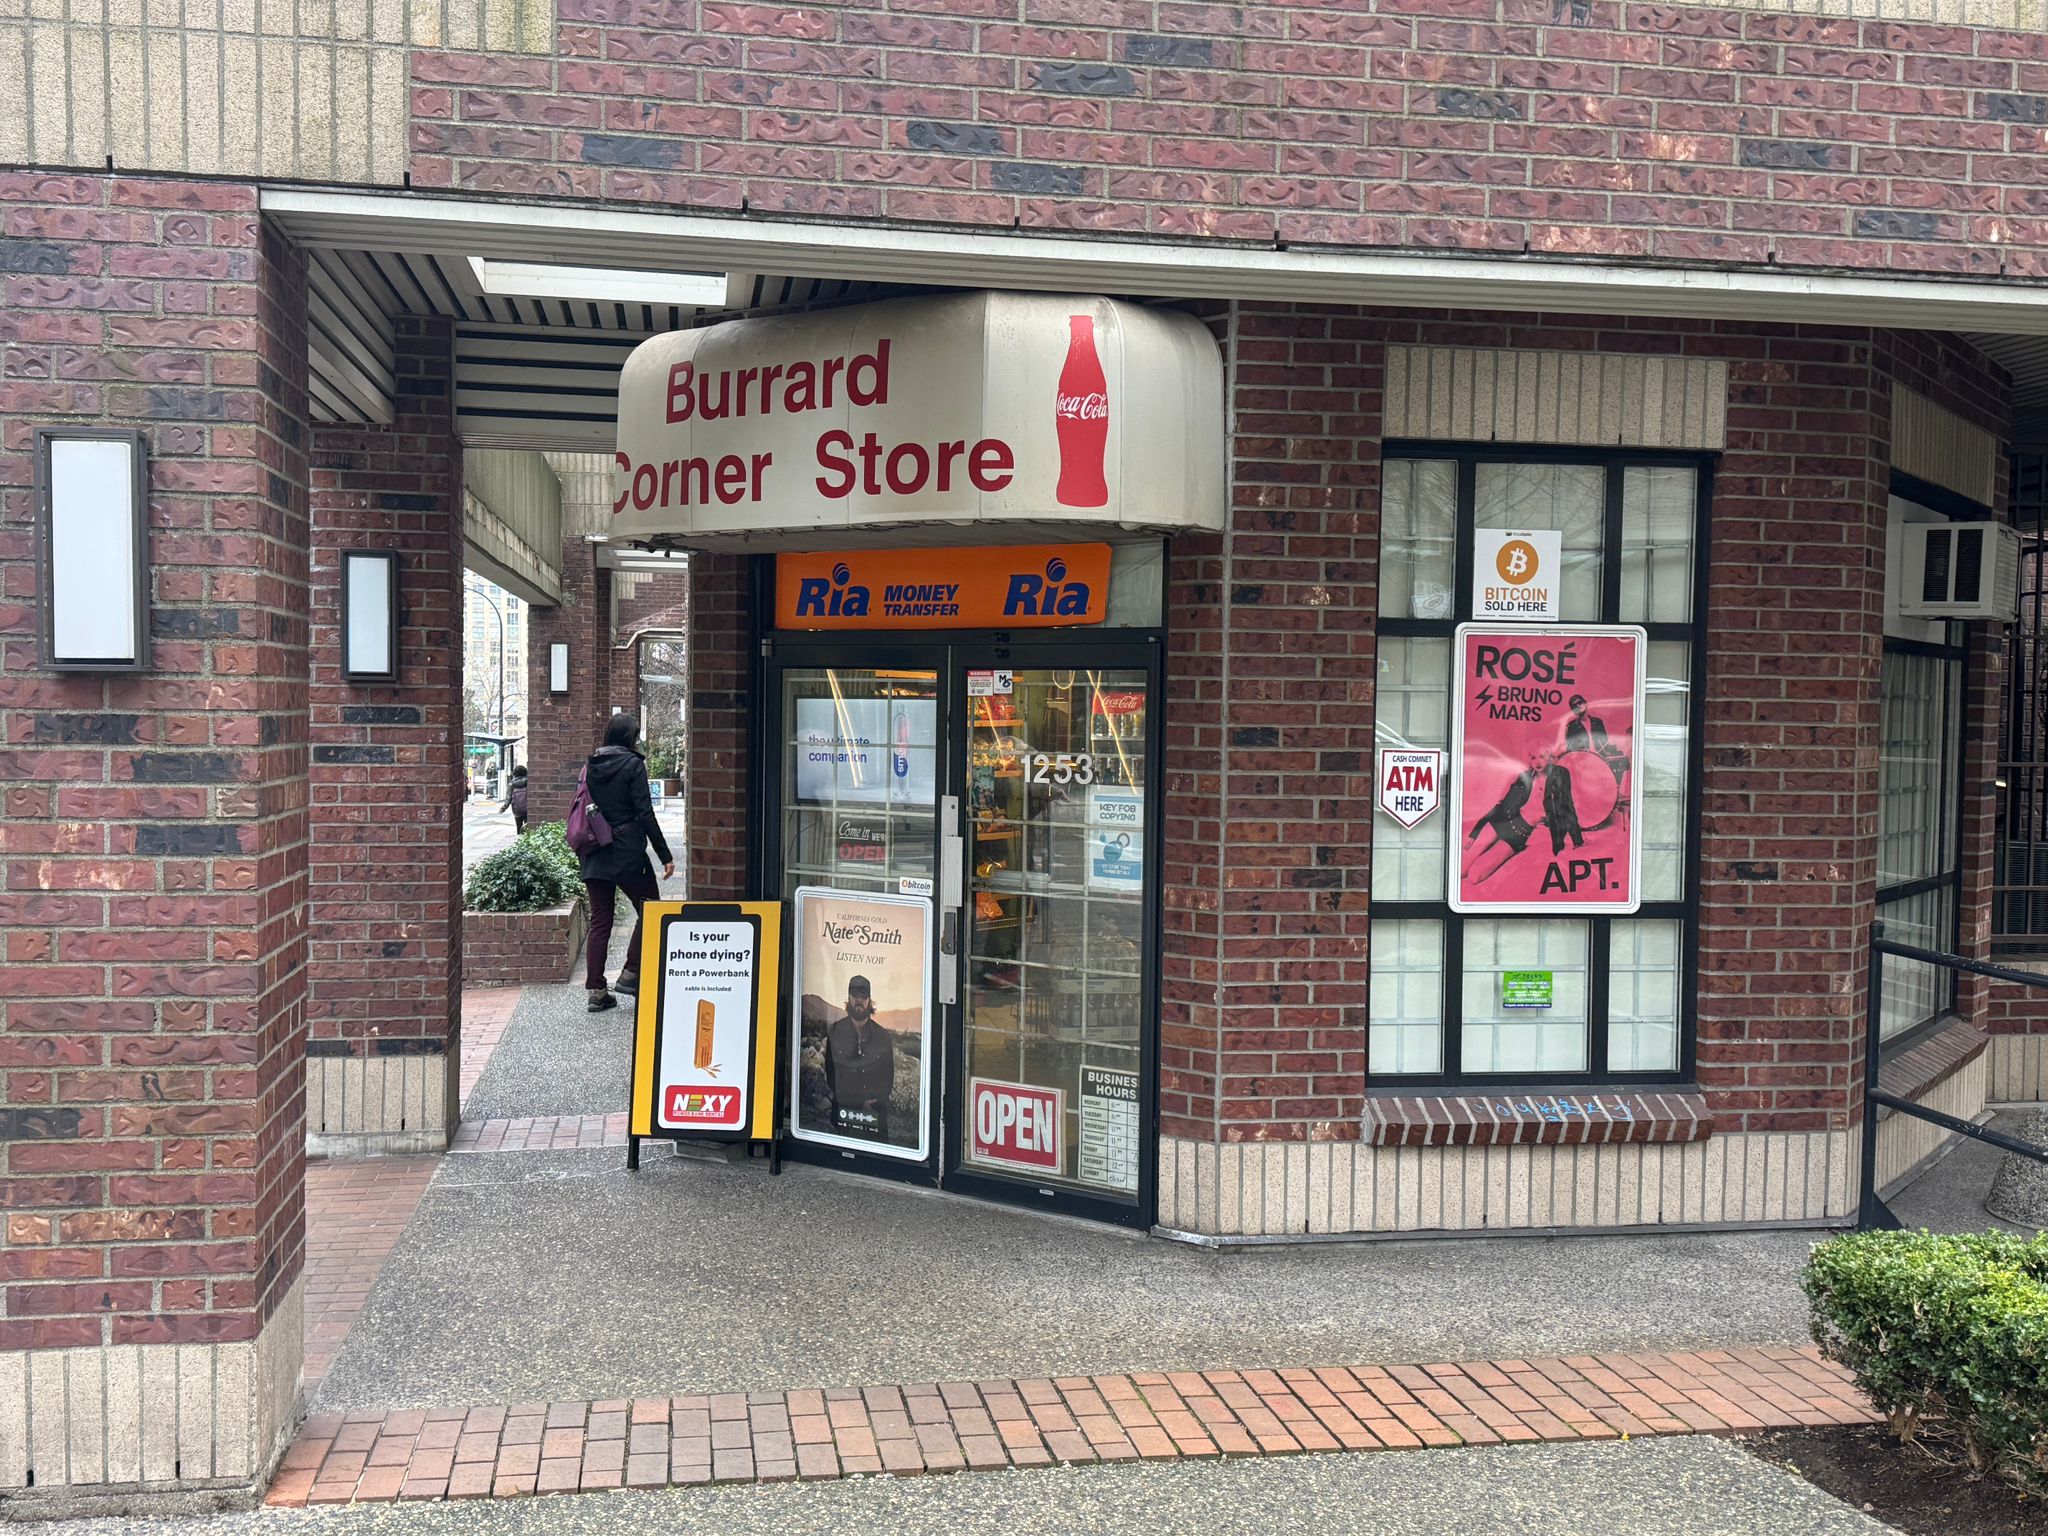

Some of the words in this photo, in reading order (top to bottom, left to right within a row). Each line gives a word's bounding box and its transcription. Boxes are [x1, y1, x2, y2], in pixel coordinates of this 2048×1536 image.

[666, 338, 891, 424] Burrard
[1057, 392, 1109, 420] Coca-Cola
[613, 451, 773, 514] Corner
[815, 429, 1015, 499] Store
[794, 562, 872, 617] Ria
[884, 584, 960, 602] MONEY
[1002, 557, 1091, 617] Ria
[1484, 587, 1548, 602] BITCOIN
[884, 603, 960, 617] TRANSFER
[1484, 601, 1515, 611] SOLD
[1517, 601, 1548, 612] HERE
[1475, 641, 1577, 685] ROSÉ
[1497, 686, 1563, 705] BRUNO
[1489, 703, 1542, 722] MARS
[808, 750, 867, 764] companion
[1392, 755, 1407, 763] CASH
[1020, 754, 1094, 785] 1253
[1385, 766, 1433, 791] ATM
[1100, 803, 1118, 812] KEY
[1119, 804, 1137, 813] FOB
[1395, 796, 1424, 811] HERE
[1099, 812, 1136, 821] COPYING
[838, 820, 862, 837] Come
[861, 826, 871, 838] in
[1538, 857, 1619, 895] APT.
[689, 931, 700, 941] Is
[702, 933, 730, 944] your
[822, 921, 854, 944] Nate
[853, 924, 902, 945] Smith
[670, 949, 707, 961] phone
[709, 949, 751, 962] dying?
[836, 951, 865, 963] LISTEN
[865, 955, 887, 965] NOW
[668, 968, 690, 977] Rent
[699, 969, 751, 978] Powerbank
[1096, 1084, 1137, 1099] HOURS
[672, 1094, 733, 1111] NEXY
[978, 1090, 1053, 1153] OPEN
